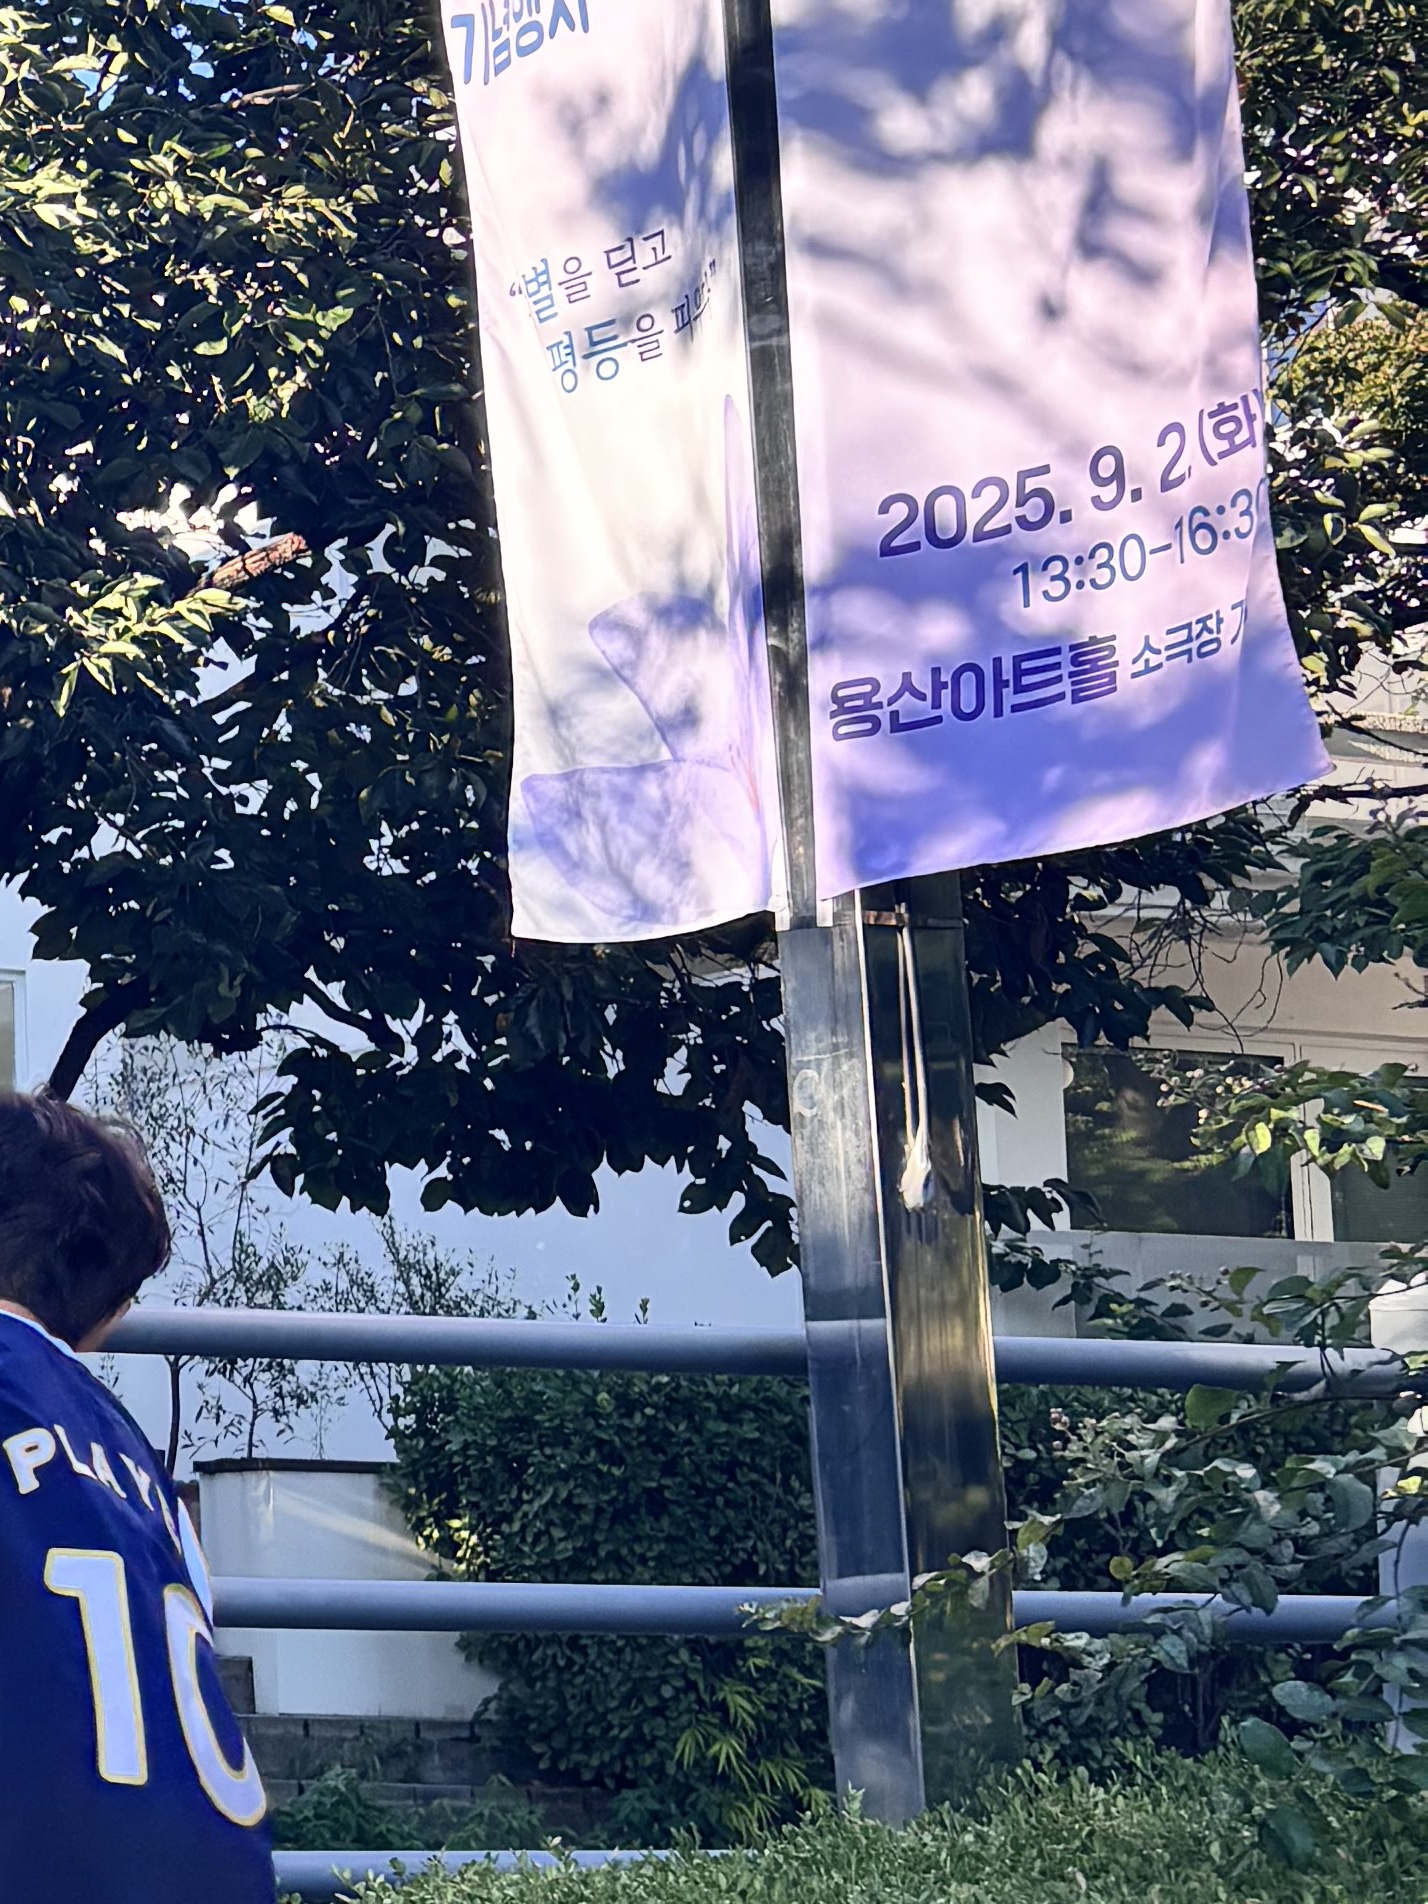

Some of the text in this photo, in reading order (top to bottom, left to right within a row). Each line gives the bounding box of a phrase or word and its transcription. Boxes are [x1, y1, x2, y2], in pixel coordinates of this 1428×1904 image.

[603, 228, 673, 289] 딛고
[546, 312, 664, 394] 평등을
[877, 464, 1074, 559] 2025.
[1088, 445, 1143, 512] 9.
[828, 633, 1120, 743] 용산아트홀
[1129, 607, 1224, 680] 소극장
[44, 1547, 268, 1827] 10
